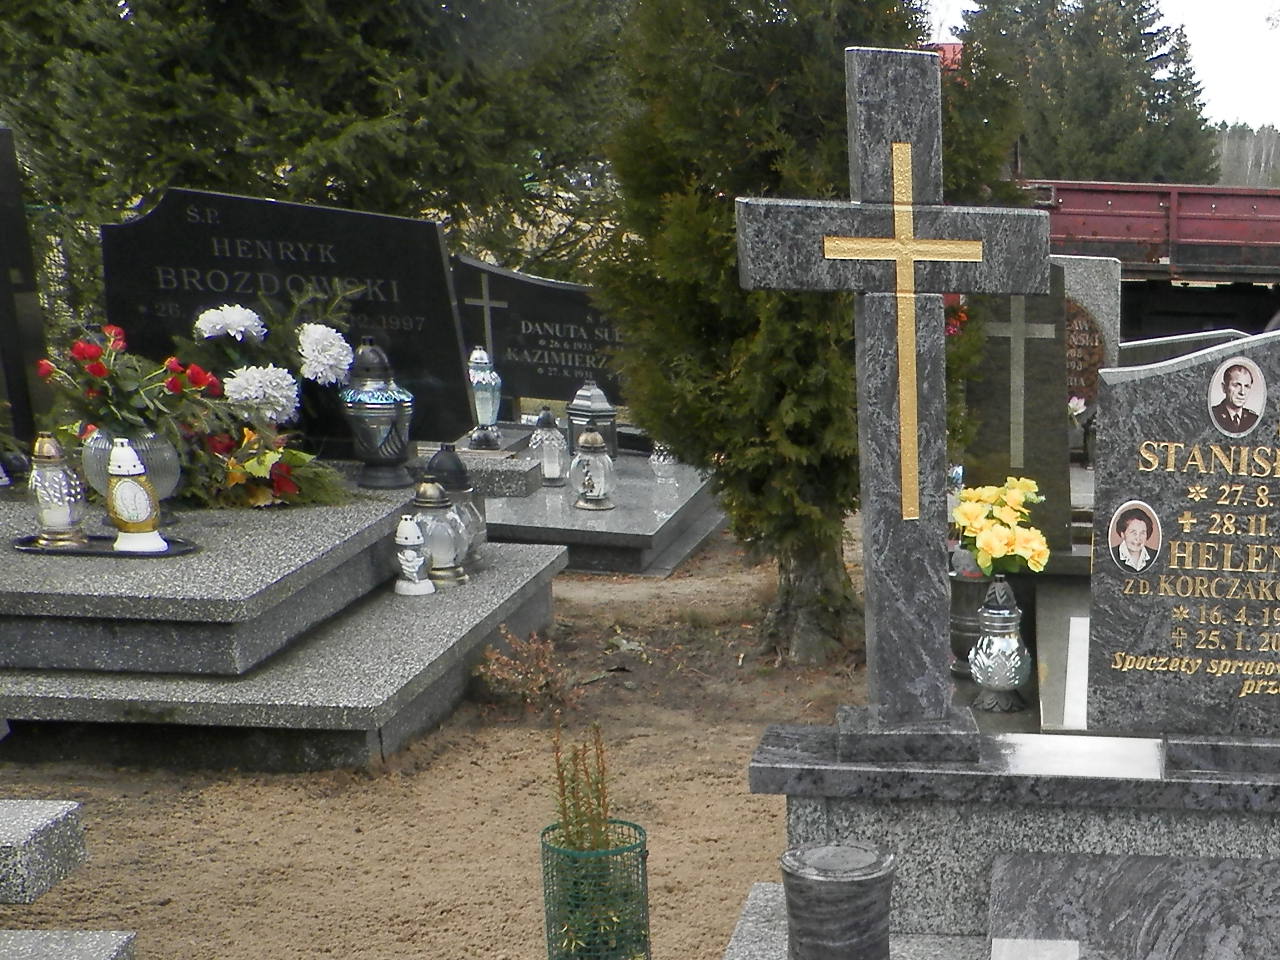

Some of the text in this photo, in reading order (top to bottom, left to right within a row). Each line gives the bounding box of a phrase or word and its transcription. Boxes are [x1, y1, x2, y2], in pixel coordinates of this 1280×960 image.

[210, 236, 337, 264] HENRYK
[154, 265, 401, 303] BROZDOWSKI
[521, 319, 588, 340] DANUTA
[505, 347, 608, 369] KAZIMIERZ
